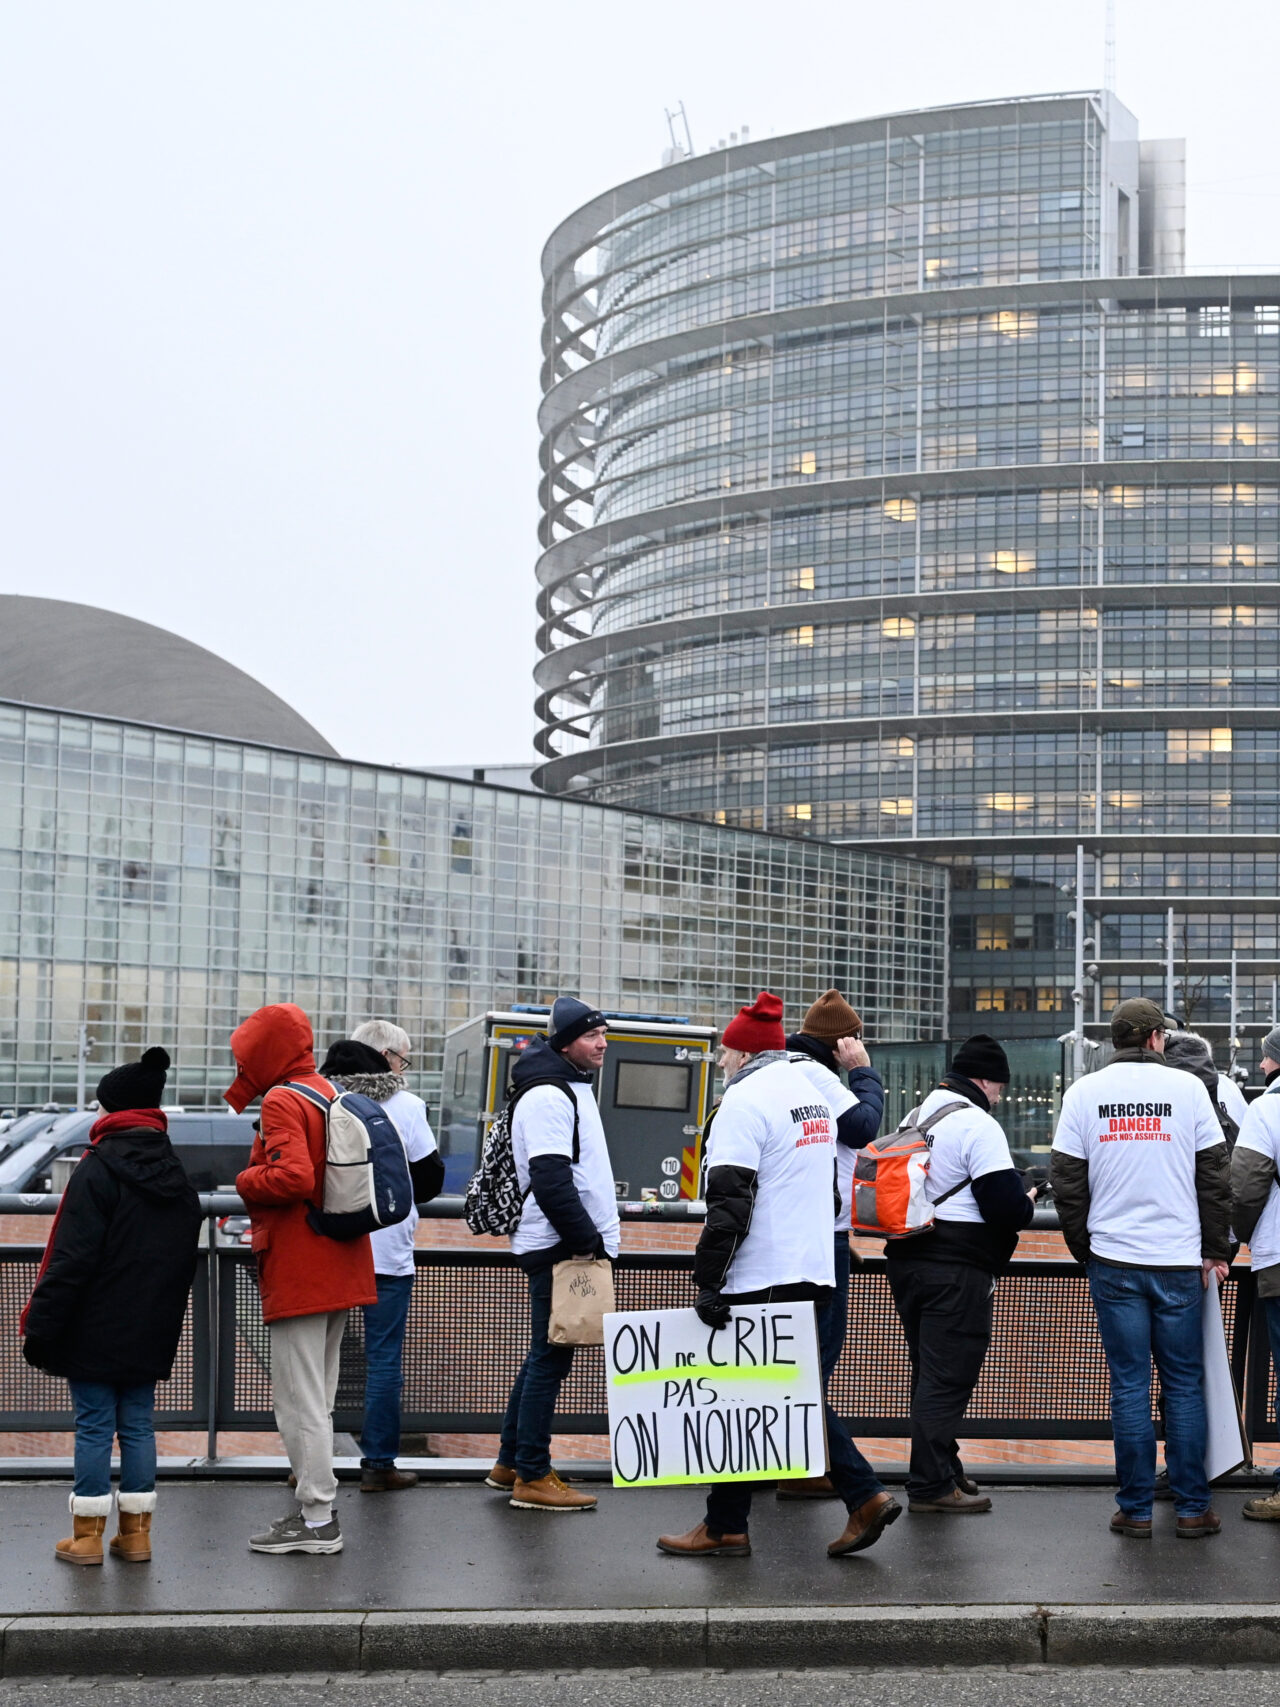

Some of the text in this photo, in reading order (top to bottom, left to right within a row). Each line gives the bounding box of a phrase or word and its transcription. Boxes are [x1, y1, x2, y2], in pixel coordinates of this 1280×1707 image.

[1098, 1103, 1172, 1119] MERCOSUR
[1109, 1117, 1161, 1133] DANGER
[1099, 1132, 1172, 1143] DANS NOS ASSIETTES
[664, 1160, 678, 1173] 110
[663, 1183, 677, 1196] 100
[613, 1309, 797, 1375] ON ne CRIE
[614, 1395, 818, 1482] ON NOURRIT
